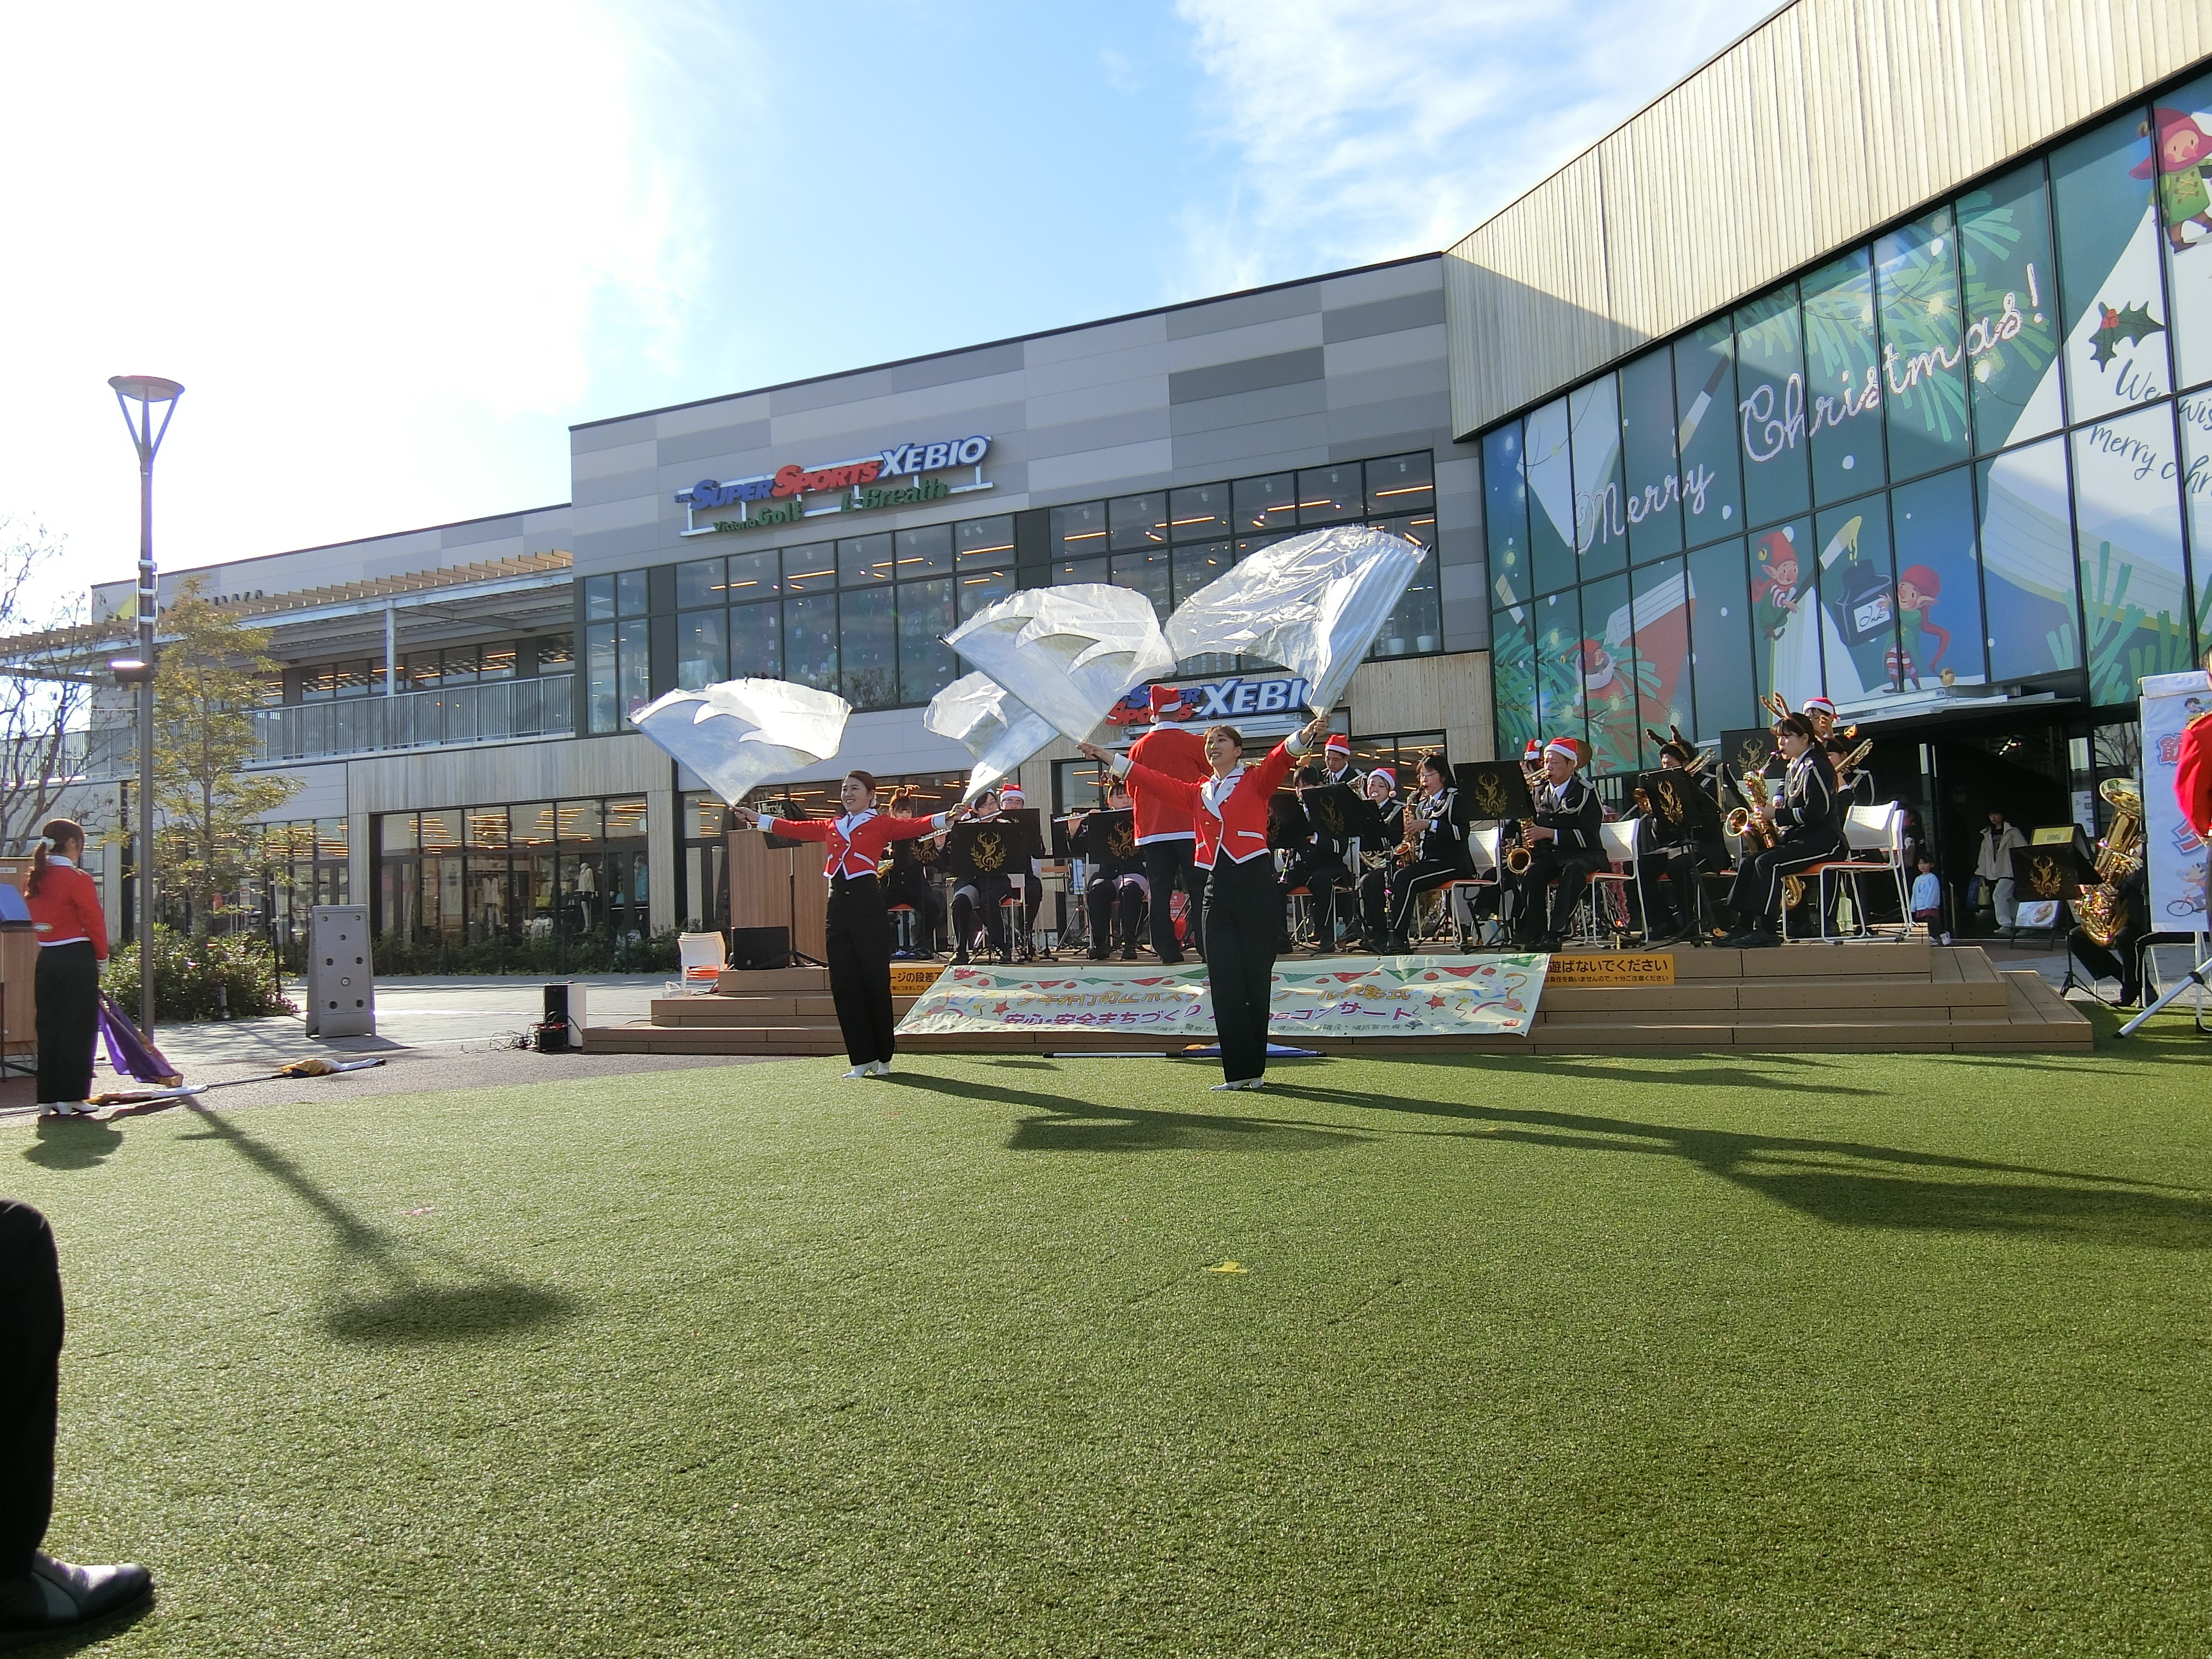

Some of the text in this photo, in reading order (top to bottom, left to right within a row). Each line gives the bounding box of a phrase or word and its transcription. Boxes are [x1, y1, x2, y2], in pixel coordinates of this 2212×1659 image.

[2116, 358, 2162, 401] We
[1573, 263, 2044, 554] Merry Christmas!
[2090, 425, 2157, 481] merry
[690, 479, 773, 510] SUPER
[771, 465, 880, 497] SPORTS
[877, 435, 990, 479] XEBIO
[840, 478, 948, 513] L-Breath
[713, 500, 804, 532] Victoria Golf
[1105, 702, 1193, 726] SPOS
[1127, 685, 1201, 708] SER
[1549, 959, 1668, 973] 遊ばないでください
